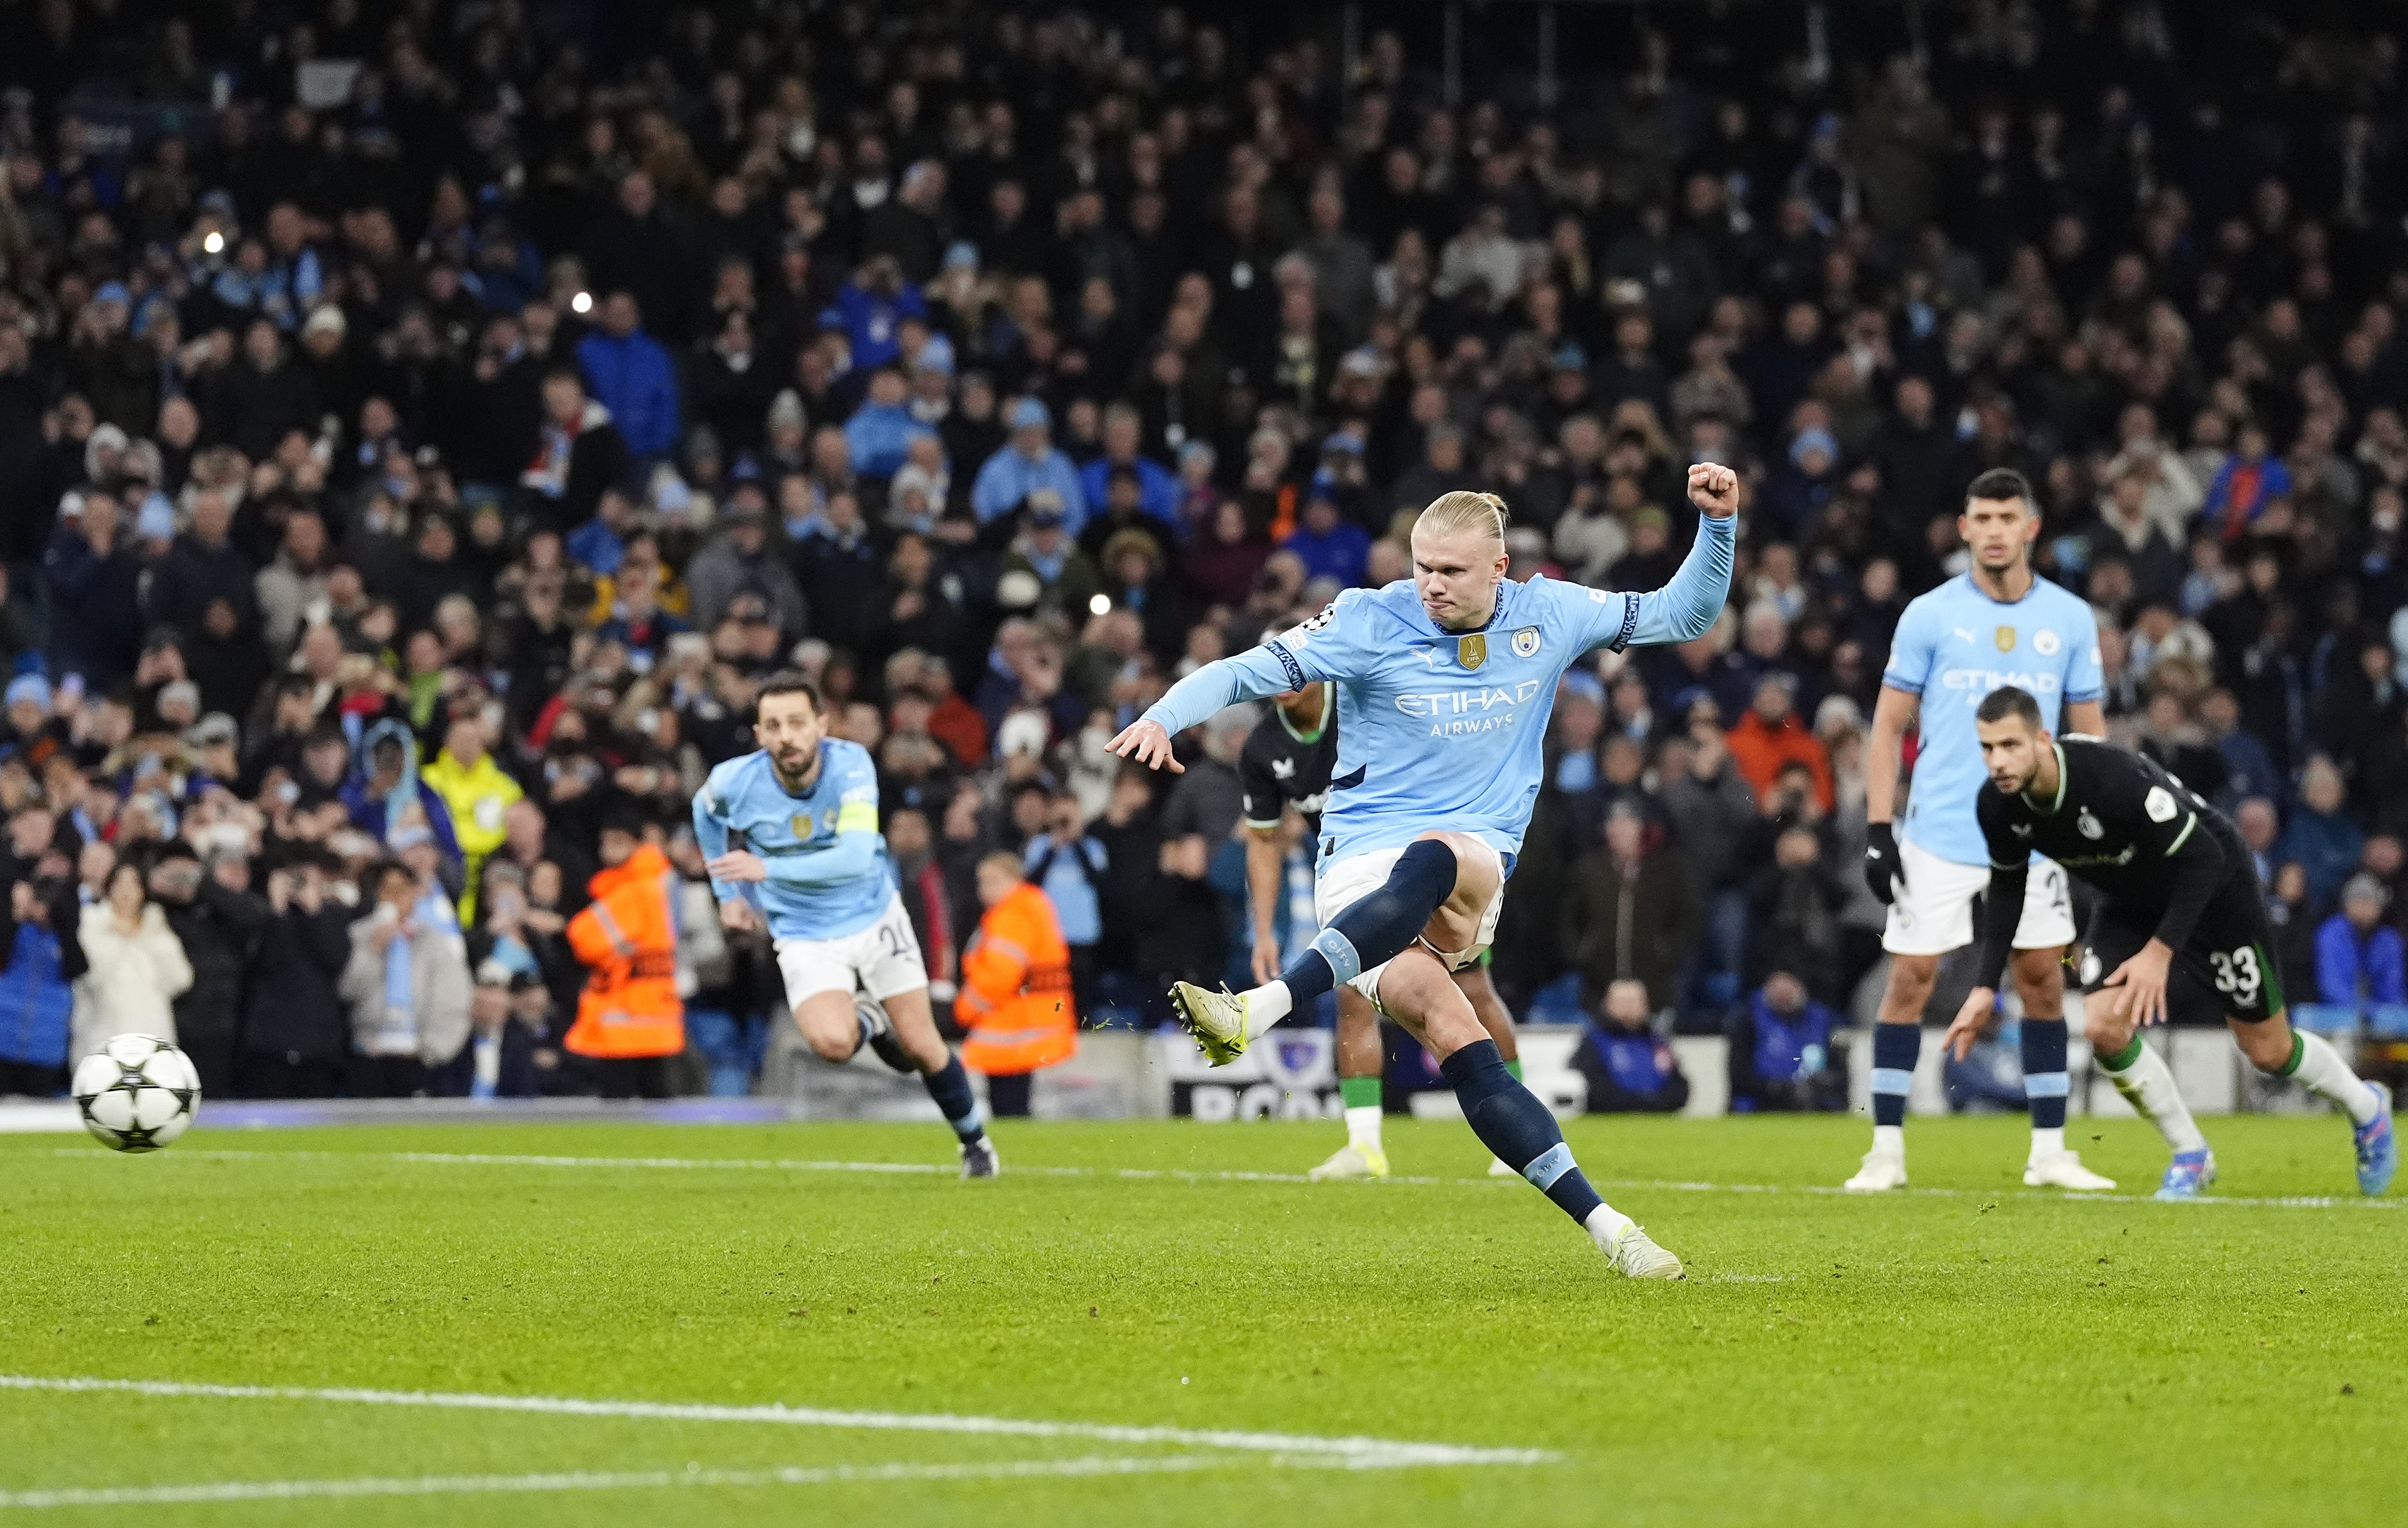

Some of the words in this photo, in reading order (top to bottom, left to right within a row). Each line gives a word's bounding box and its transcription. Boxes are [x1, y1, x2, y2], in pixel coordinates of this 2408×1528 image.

[1942, 669, 2059, 692] ETIHAD
[1395, 680, 1539, 716] ETIHAD
[1430, 713, 1513, 736] AIRWAYS
[2210, 945, 2262, 992] 33
